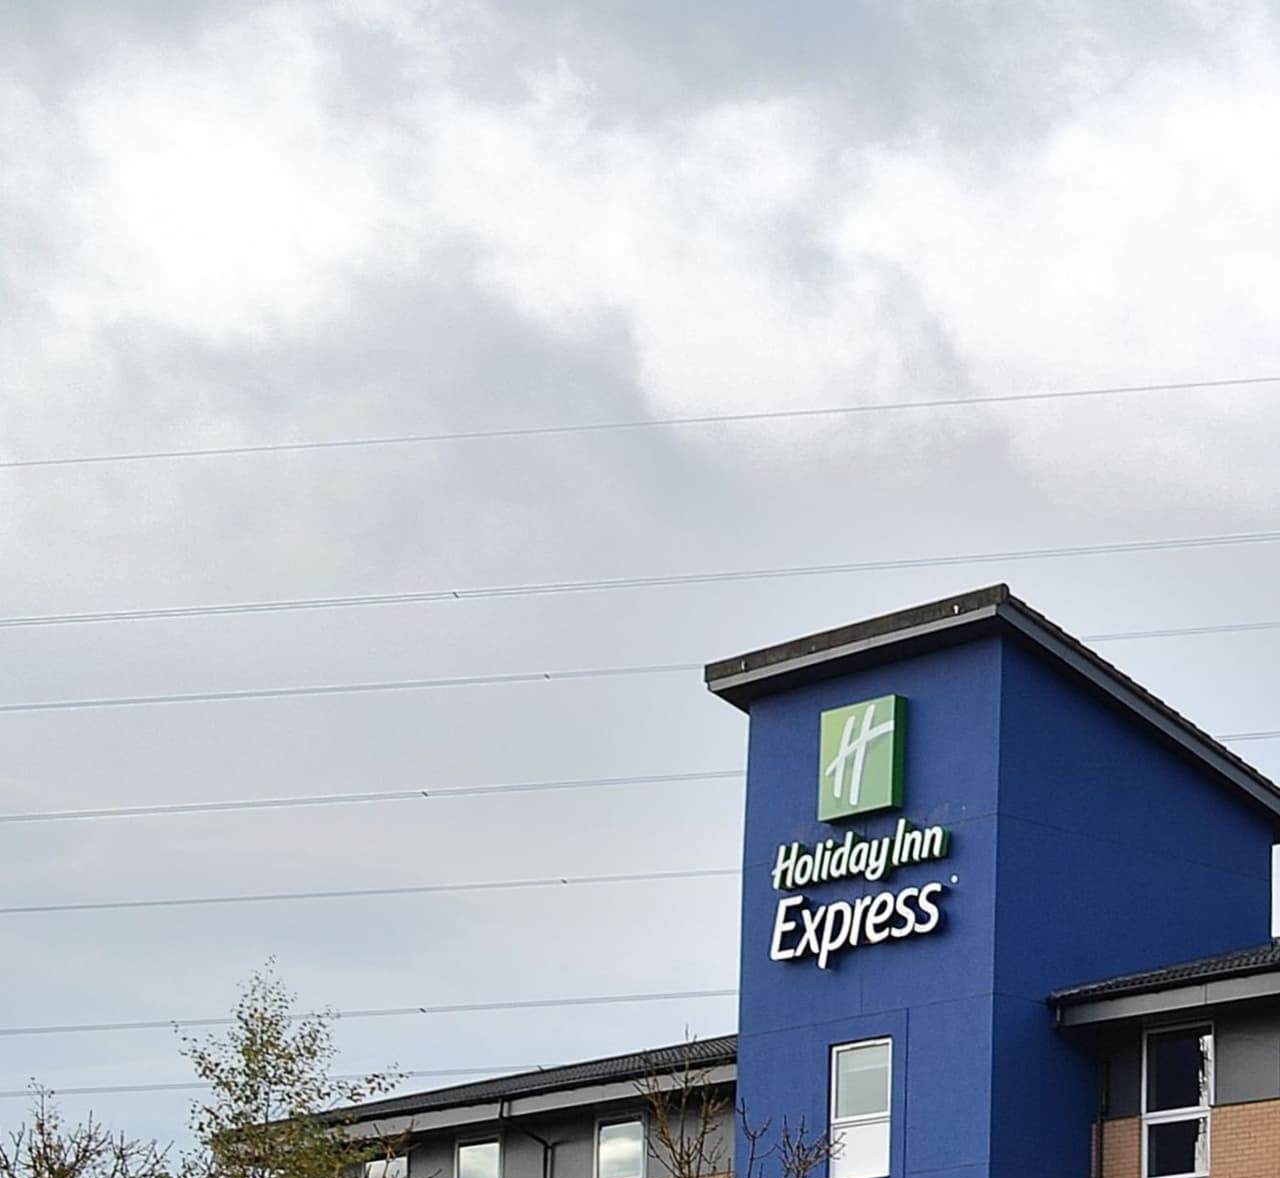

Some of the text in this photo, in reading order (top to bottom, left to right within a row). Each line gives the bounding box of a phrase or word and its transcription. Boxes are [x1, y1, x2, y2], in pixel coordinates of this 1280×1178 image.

[771, 818, 944, 890] Holiday Inn
[769, 882, 943, 970] Express
